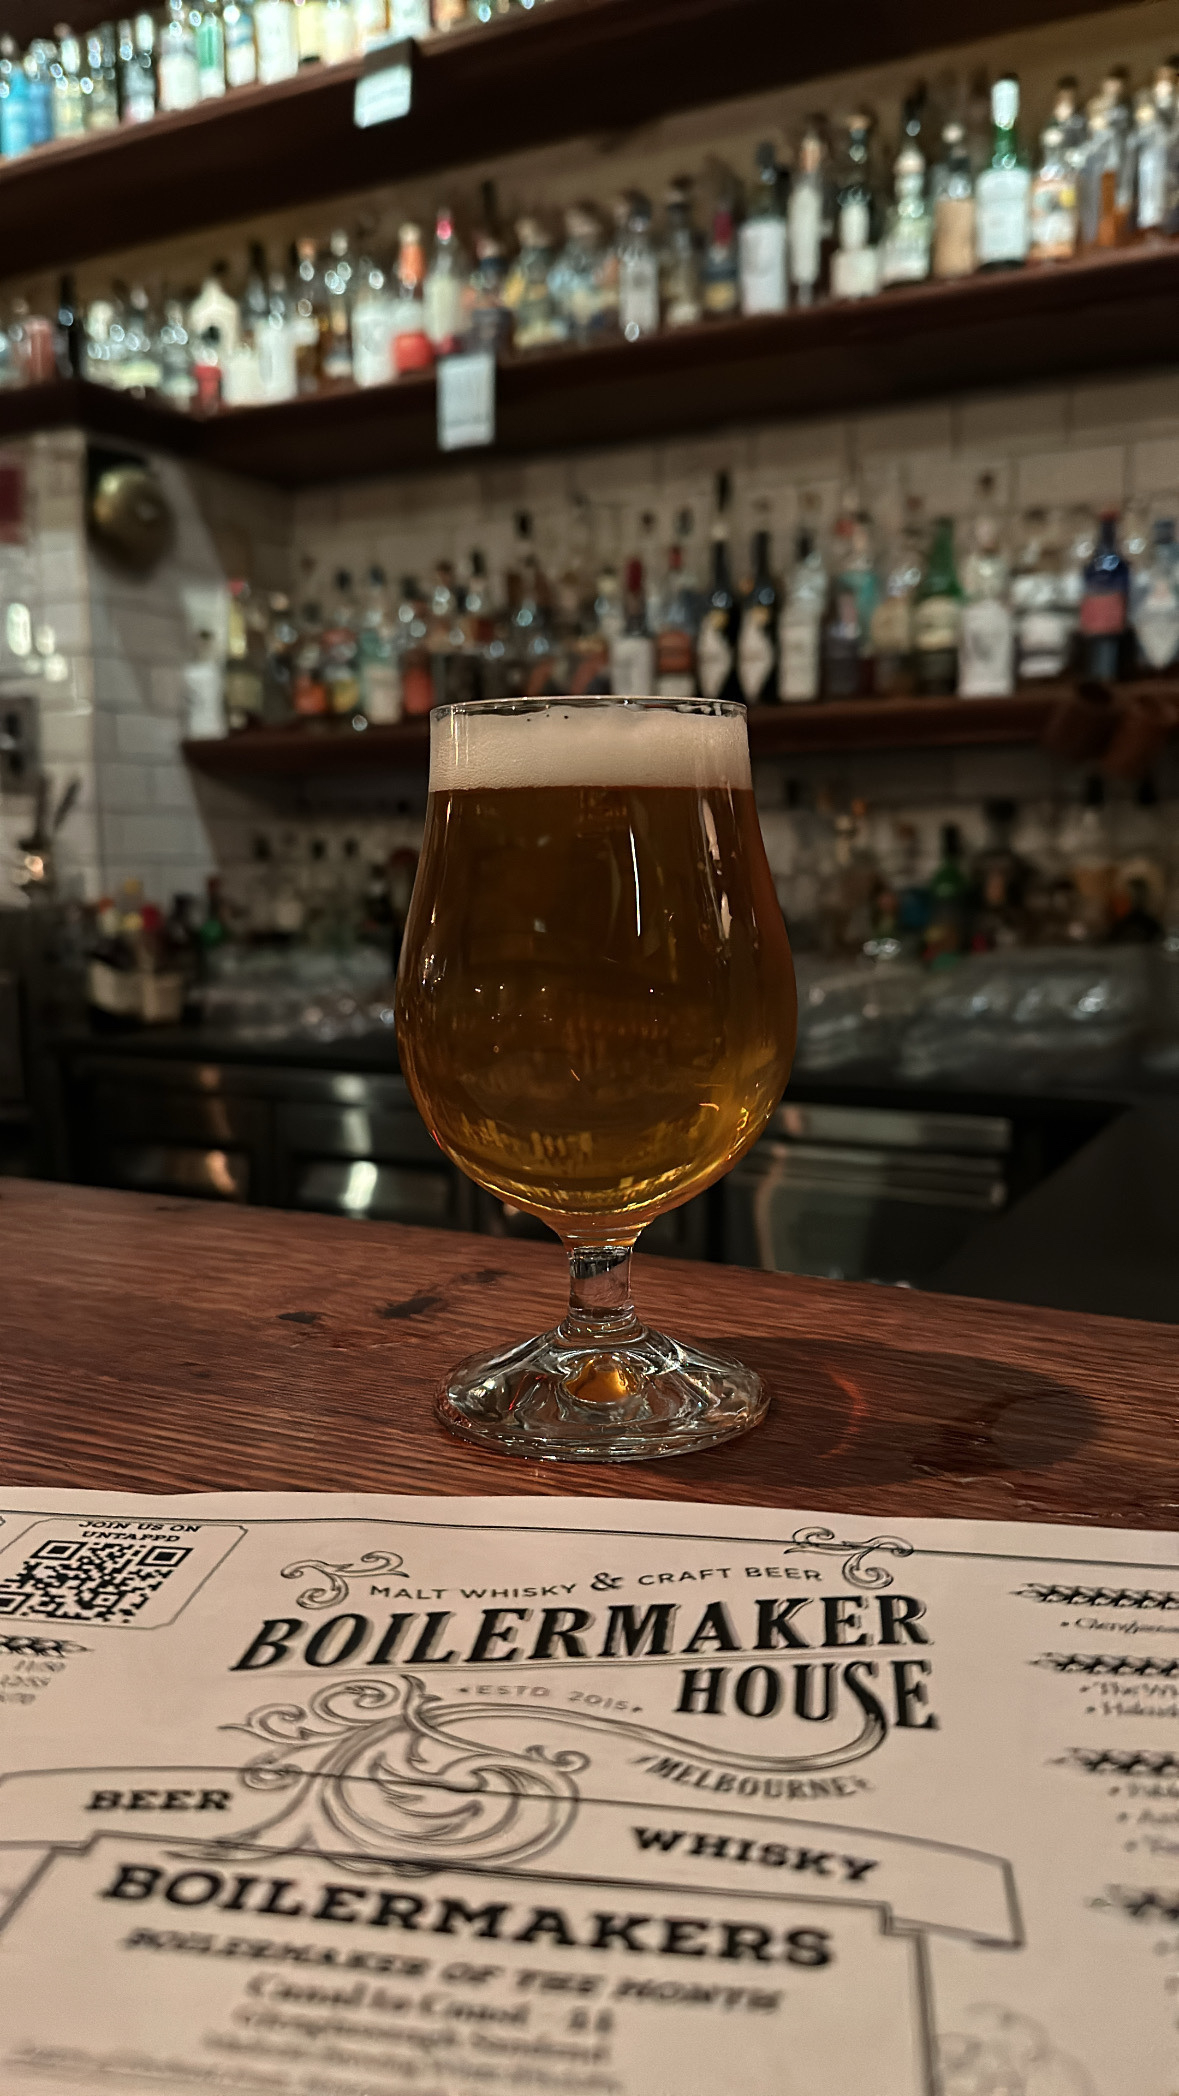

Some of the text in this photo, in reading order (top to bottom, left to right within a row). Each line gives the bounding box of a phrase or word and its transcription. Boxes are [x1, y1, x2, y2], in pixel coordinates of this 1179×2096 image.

[78, 1520, 202, 1533] JOIN US ON
[81, 1530, 181, 1543] UNTAPPD
[369, 1565, 823, 1600] MALT WHISKY & CRAFT BEER
[229, 1592, 934, 1673] BOILERMAKER
[674, 1658, 941, 1731] HOUSE
[645, 1755, 867, 1800] MELBOURNE
[83, 1788, 233, 1814] BEER
[631, 1824, 882, 1885] WHISKY
[100, 1861, 836, 1969] BOILERMAKERS
